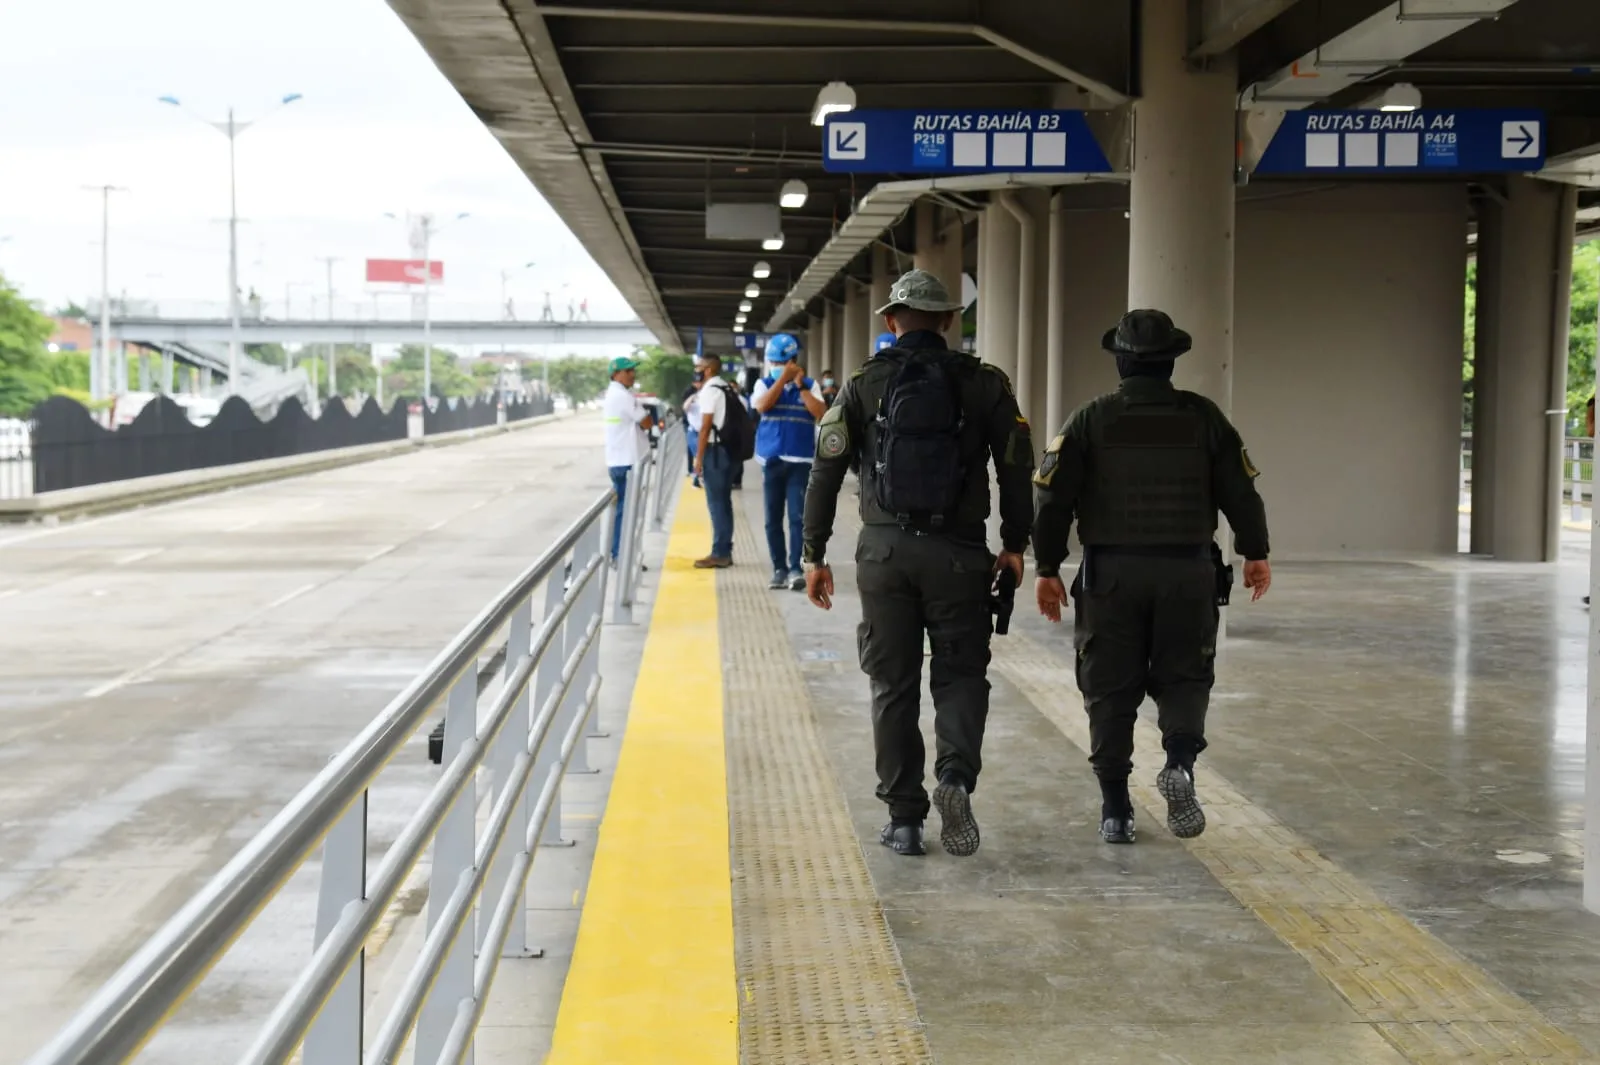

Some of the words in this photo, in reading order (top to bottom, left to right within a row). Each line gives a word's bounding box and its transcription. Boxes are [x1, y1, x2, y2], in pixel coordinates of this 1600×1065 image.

[913, 114, 972, 130] RUTAS
[976, 111, 1032, 130] BAHÍA
[1037, 114, 1060, 130] B3
[1306, 114, 1365, 130] RUTAS
[1369, 111, 1425, 130] BAHÍA
[1430, 114, 1456, 129] A4
[914, 133, 945, 144] P21B
[1424, 132, 1456, 144] P47B
